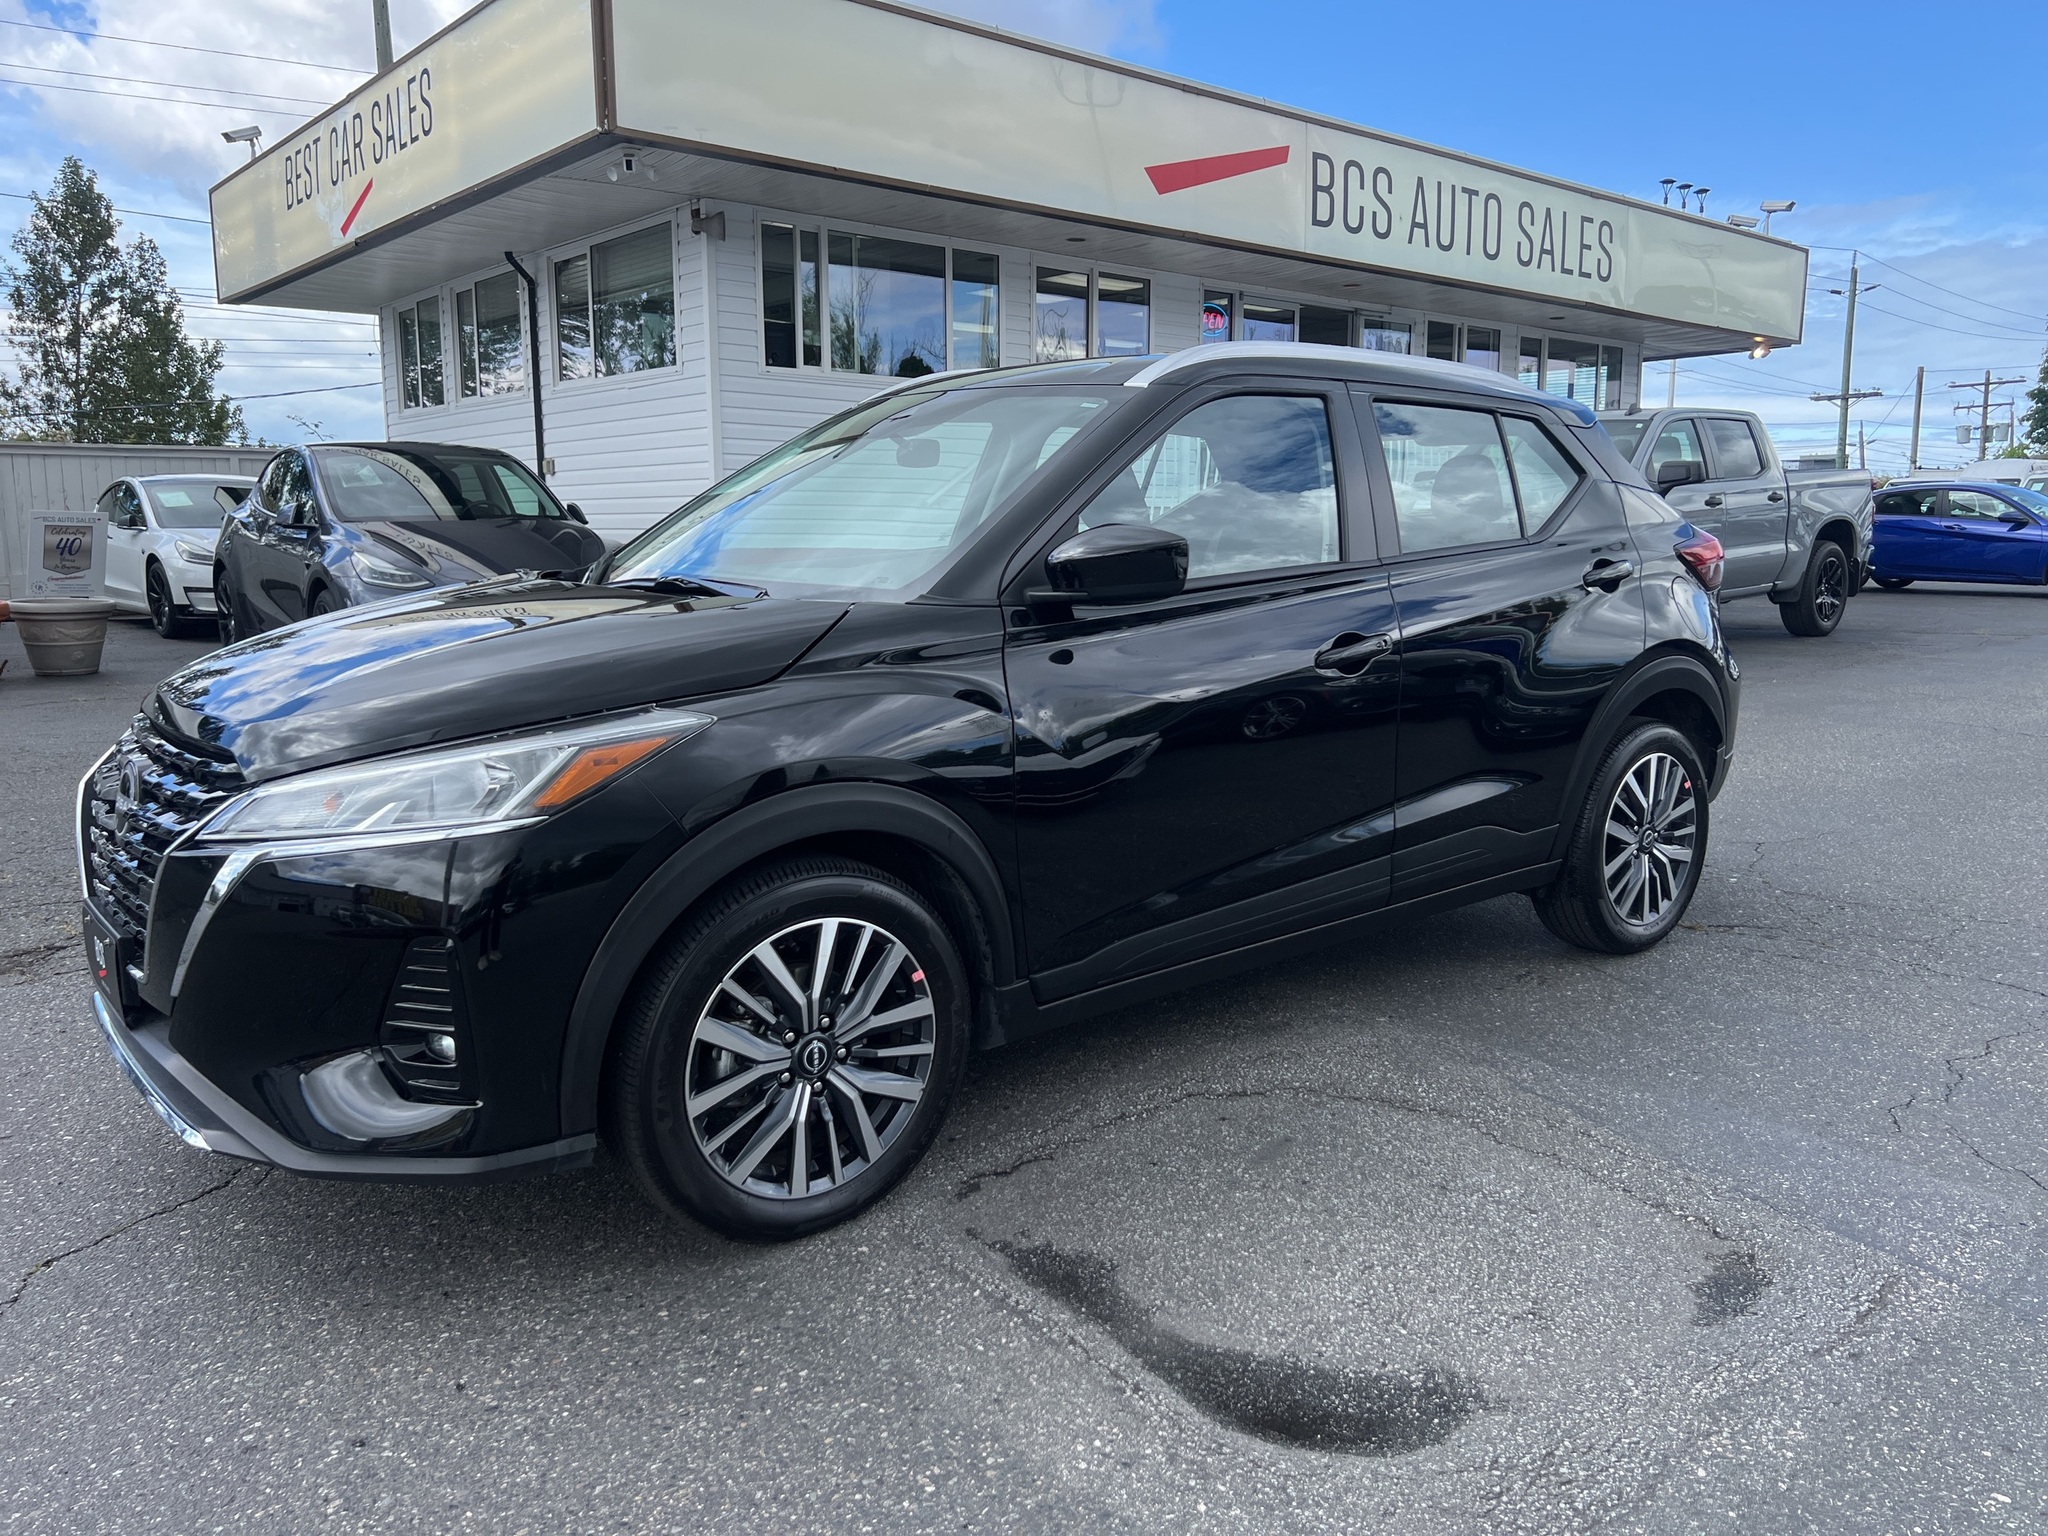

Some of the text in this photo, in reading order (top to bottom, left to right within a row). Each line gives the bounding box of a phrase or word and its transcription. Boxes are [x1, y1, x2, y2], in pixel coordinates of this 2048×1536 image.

[285, 67, 433, 211] BEST CAR SALES
[1311, 151, 1614, 283] BCS AUTO SALES
[1203, 311, 1225, 329] PEN
[51, 527, 86, 537] Celebrating
[56, 537, 82, 556] 40
